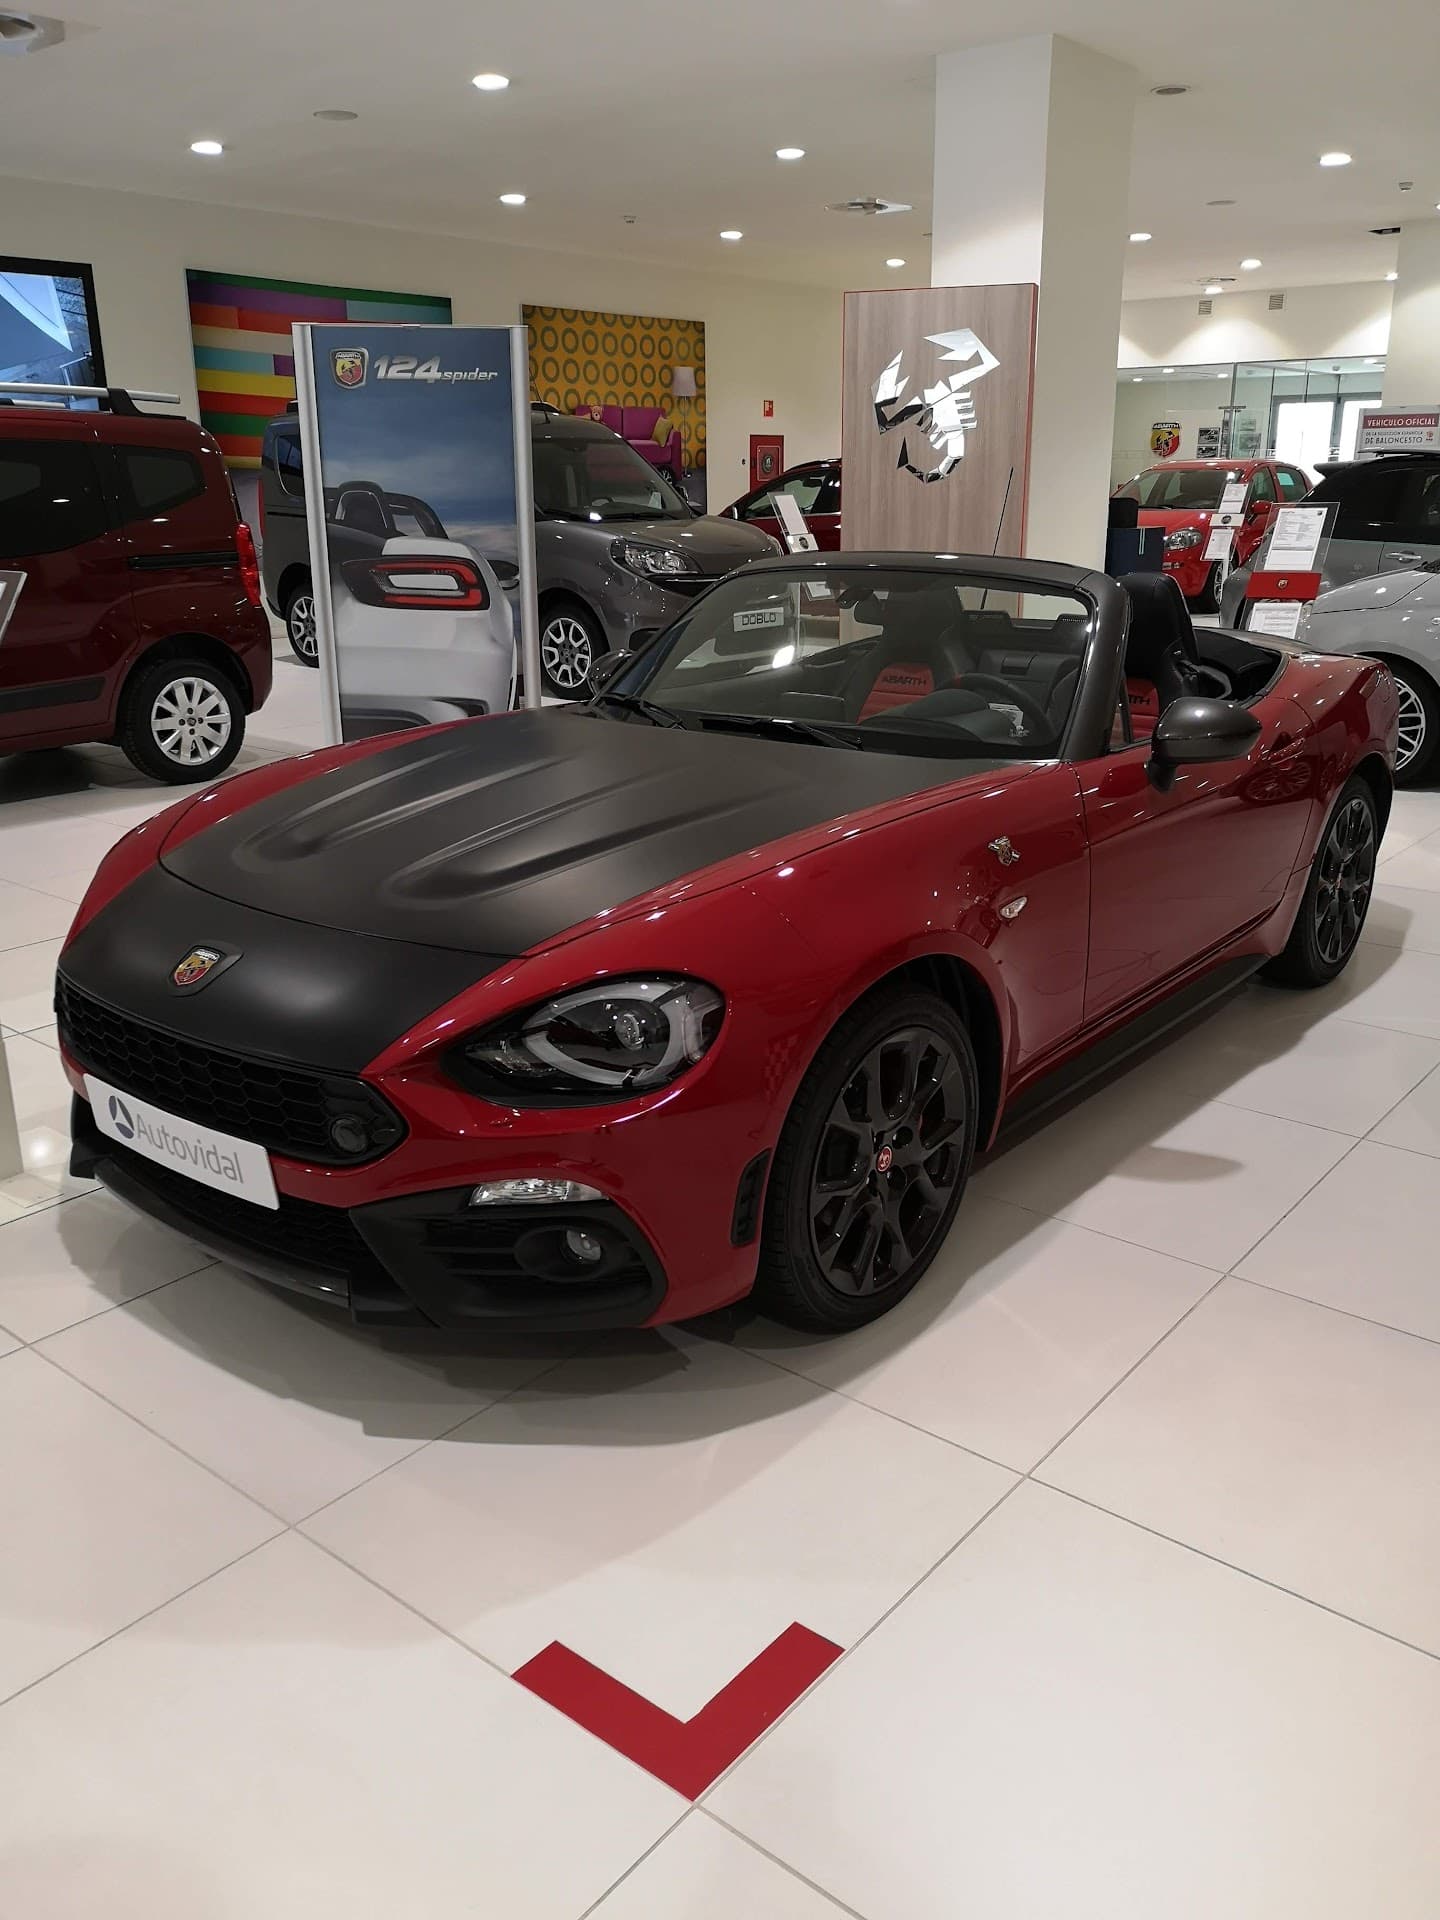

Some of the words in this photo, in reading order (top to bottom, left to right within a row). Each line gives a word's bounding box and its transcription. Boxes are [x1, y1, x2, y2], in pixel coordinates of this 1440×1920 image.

[374, 355, 441, 383] 124
[441, 368, 498, 384] spider
[1405, 417, 1436, 426] OFICIAL
[1375, 436, 1423, 444] BALONCESTO
[136, 1113, 244, 1184] Autovidal
